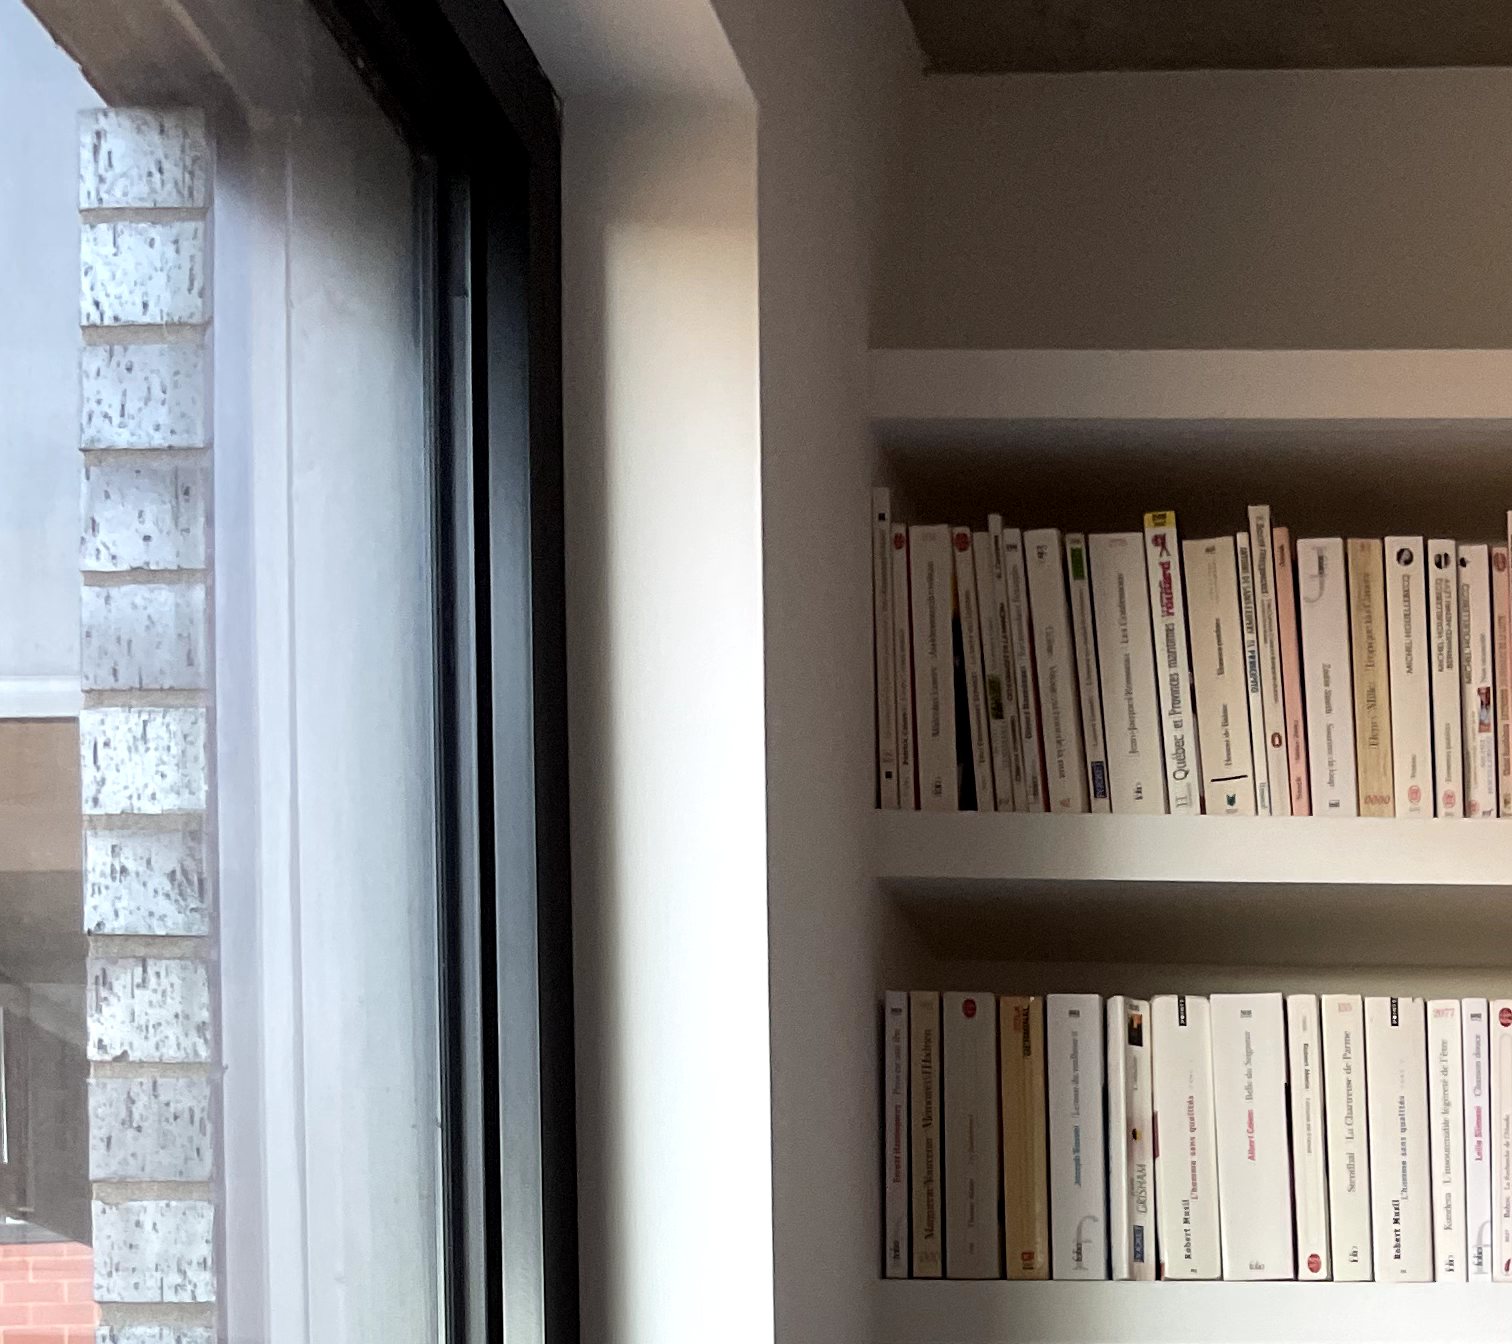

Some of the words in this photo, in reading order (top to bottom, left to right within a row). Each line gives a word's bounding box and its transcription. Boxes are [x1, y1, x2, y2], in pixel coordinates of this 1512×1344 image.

[1167, 672, 1182, 715] Provinces
[1174, 719, 1183, 728] et
[1172, 734, 1189, 780] Québec
[1188, 1161, 1198, 1200] L'homme
[1182, 1200, 1190, 1224] Musil
[1184, 1228, 1192, 1260] Robert
